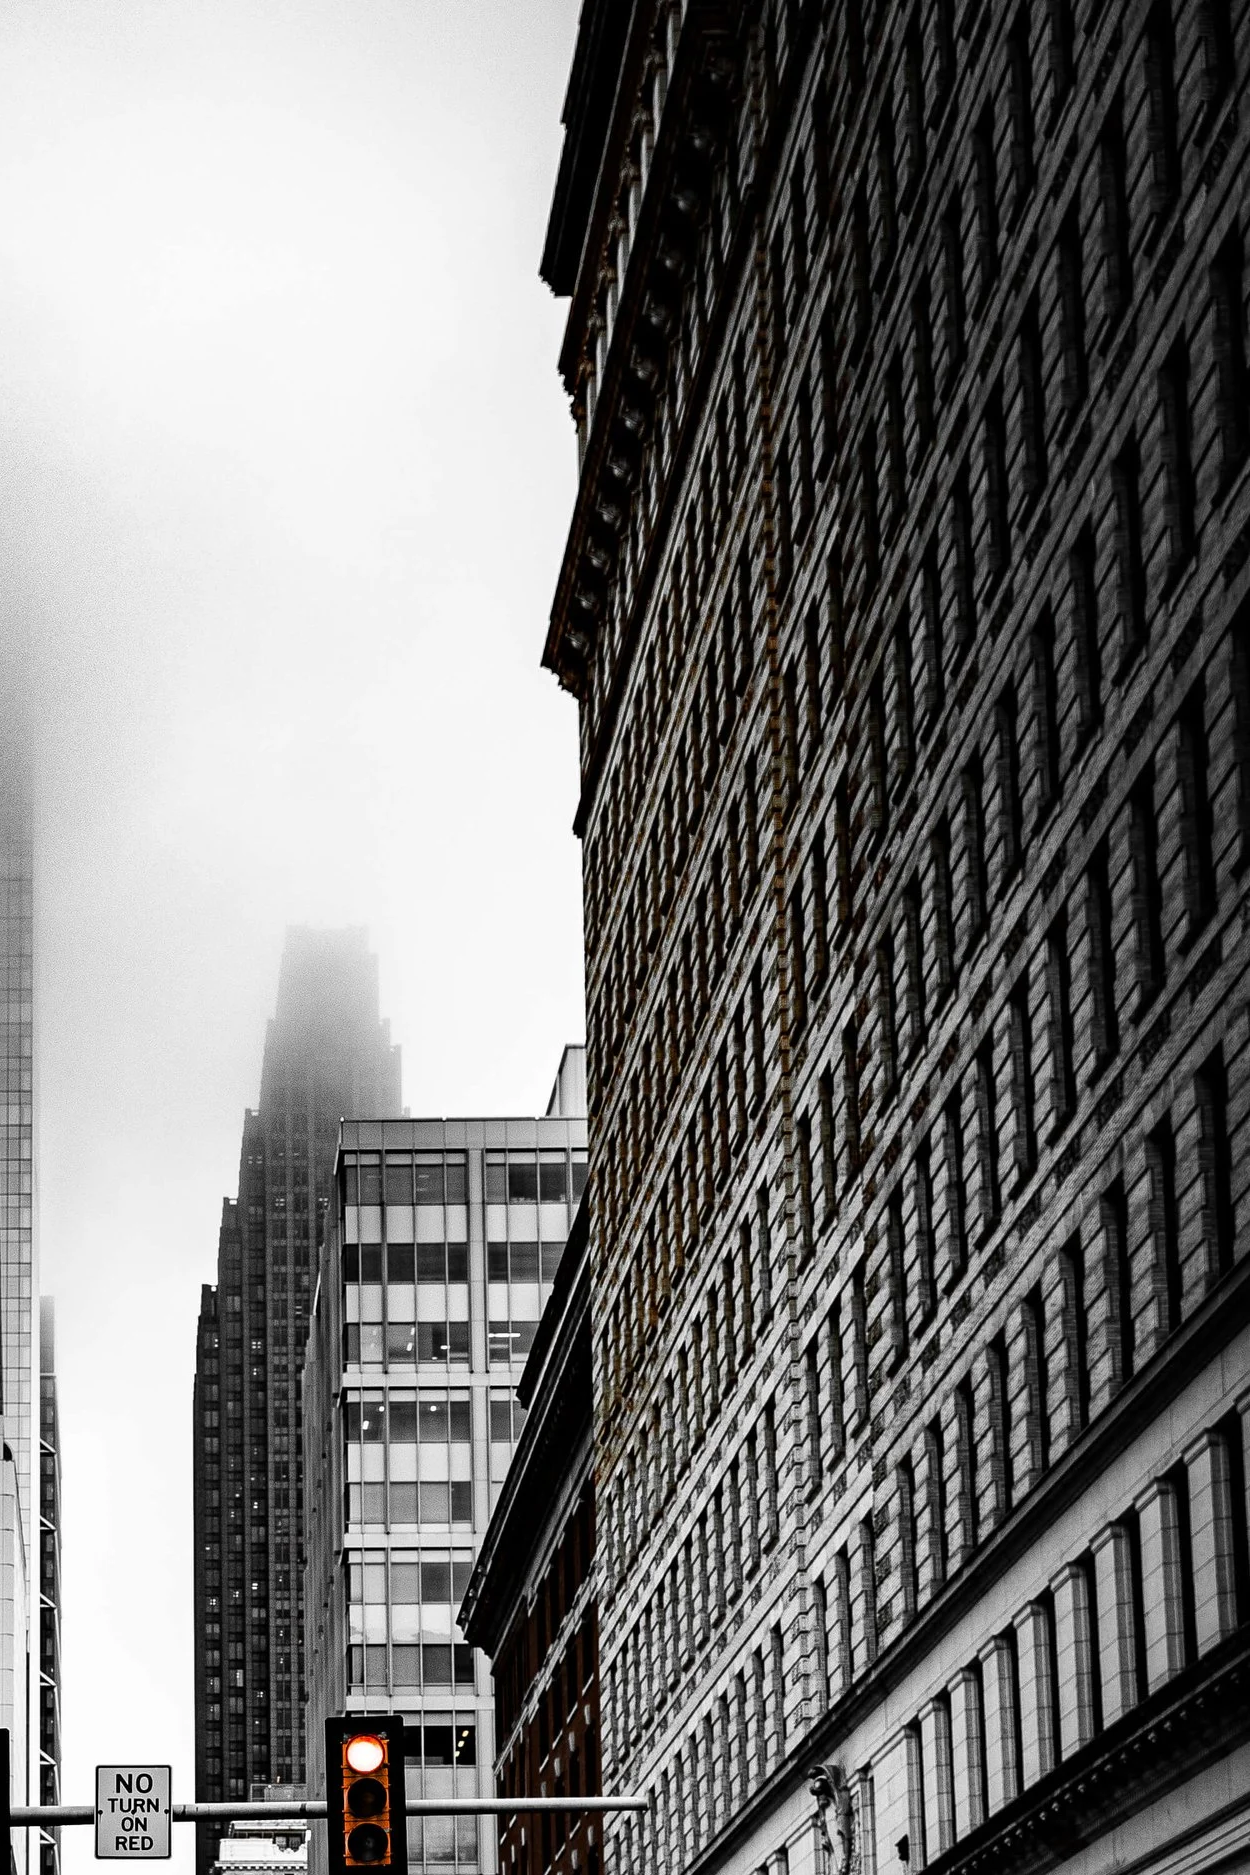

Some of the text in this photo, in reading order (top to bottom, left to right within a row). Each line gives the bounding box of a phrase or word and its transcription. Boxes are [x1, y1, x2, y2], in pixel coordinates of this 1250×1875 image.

[116, 1773, 153, 1794] NO
[107, 1798, 160, 1813] TURN
[121, 1817, 147, 1832] ON
[115, 1836, 154, 1850] RED
